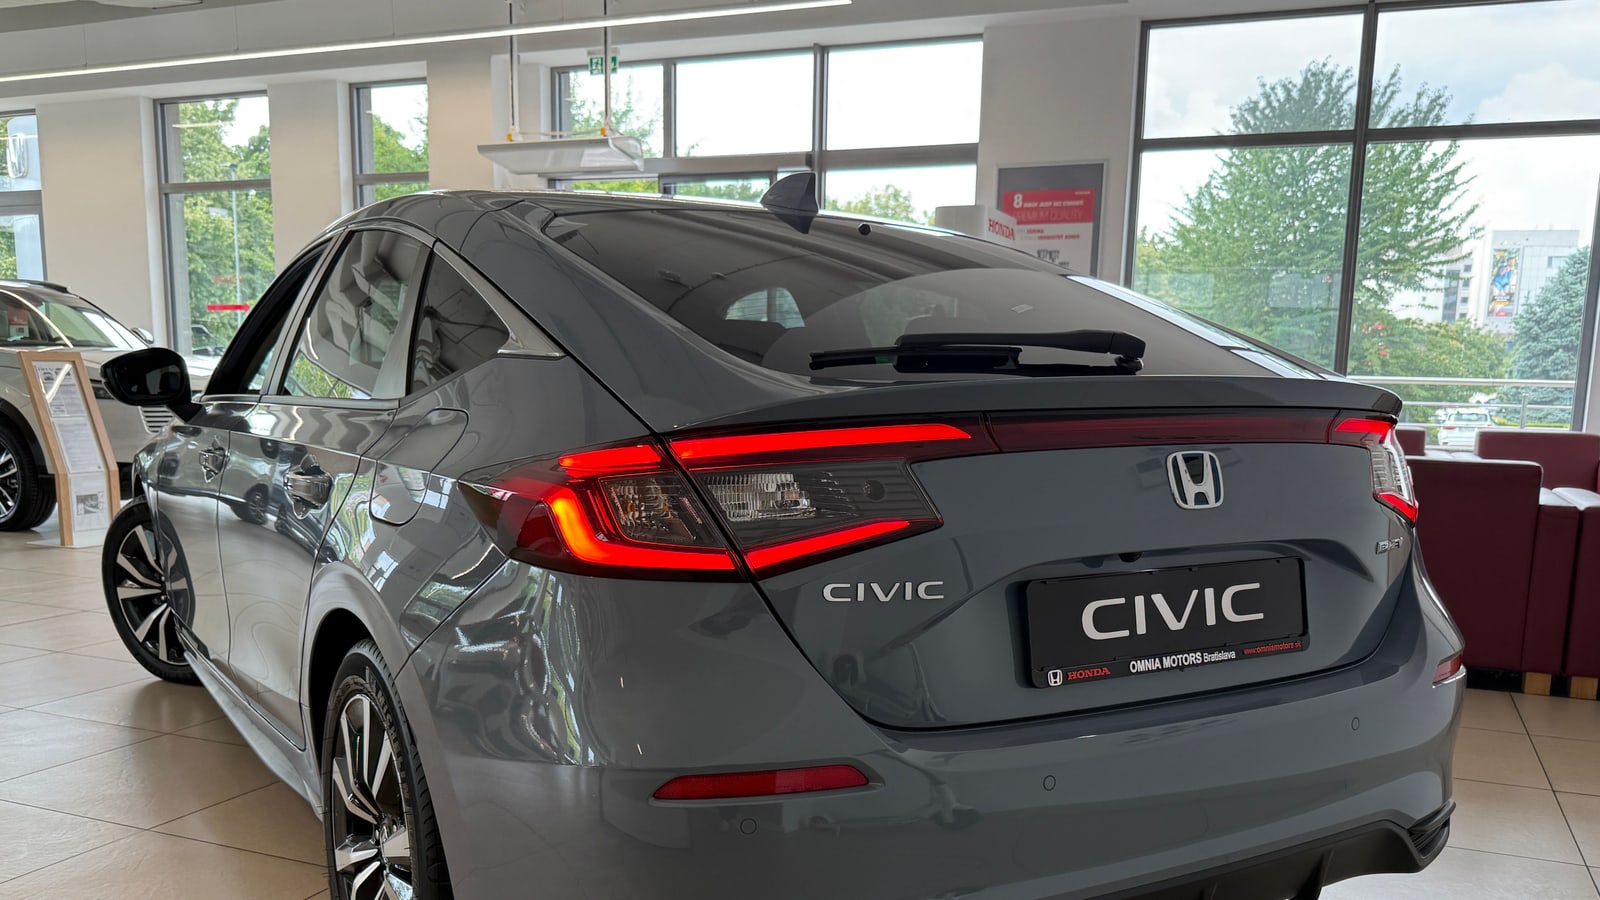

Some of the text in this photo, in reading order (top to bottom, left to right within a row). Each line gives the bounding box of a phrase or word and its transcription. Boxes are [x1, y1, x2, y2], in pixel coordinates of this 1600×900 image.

[1013, 193, 1023, 208] 8
[988, 218, 1015, 240] HONDA
[823, 581, 945, 602] CIVIC
[1081, 582, 1264, 640] CIVIC
[1067, 667, 1111, 681] HONDA
[1129, 658, 1162, 673] OMNIA
[1162, 652, 1203, 669] MOTORS
[1203, 650, 1236, 663] Bratislava
[1242, 641, 1302, 655] www.omniamotors.sk
